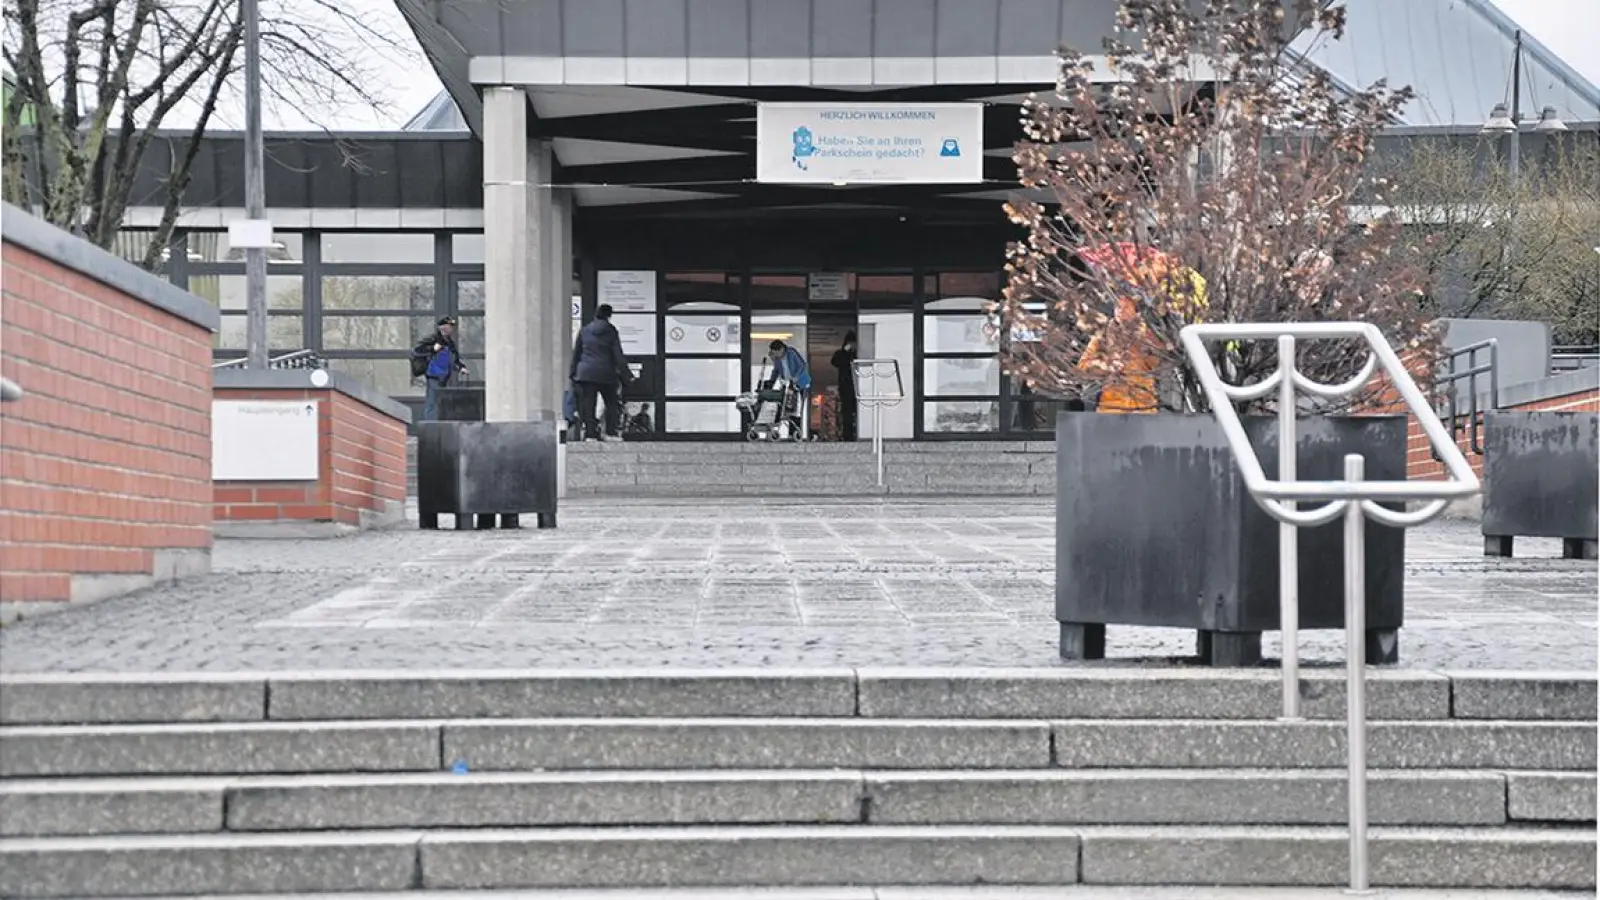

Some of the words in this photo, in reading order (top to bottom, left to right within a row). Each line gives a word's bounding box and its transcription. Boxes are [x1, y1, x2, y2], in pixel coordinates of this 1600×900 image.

[820, 111, 866, 120] HERZLICH
[868, 111, 936, 120] WILLKOMMEN
[856, 135, 875, 146] Sie
[877, 137, 890, 146] an
[893, 136, 922, 146] Ihren
[814, 148, 873, 158] Parkschein
[875, 148, 925, 160] gedacht?
